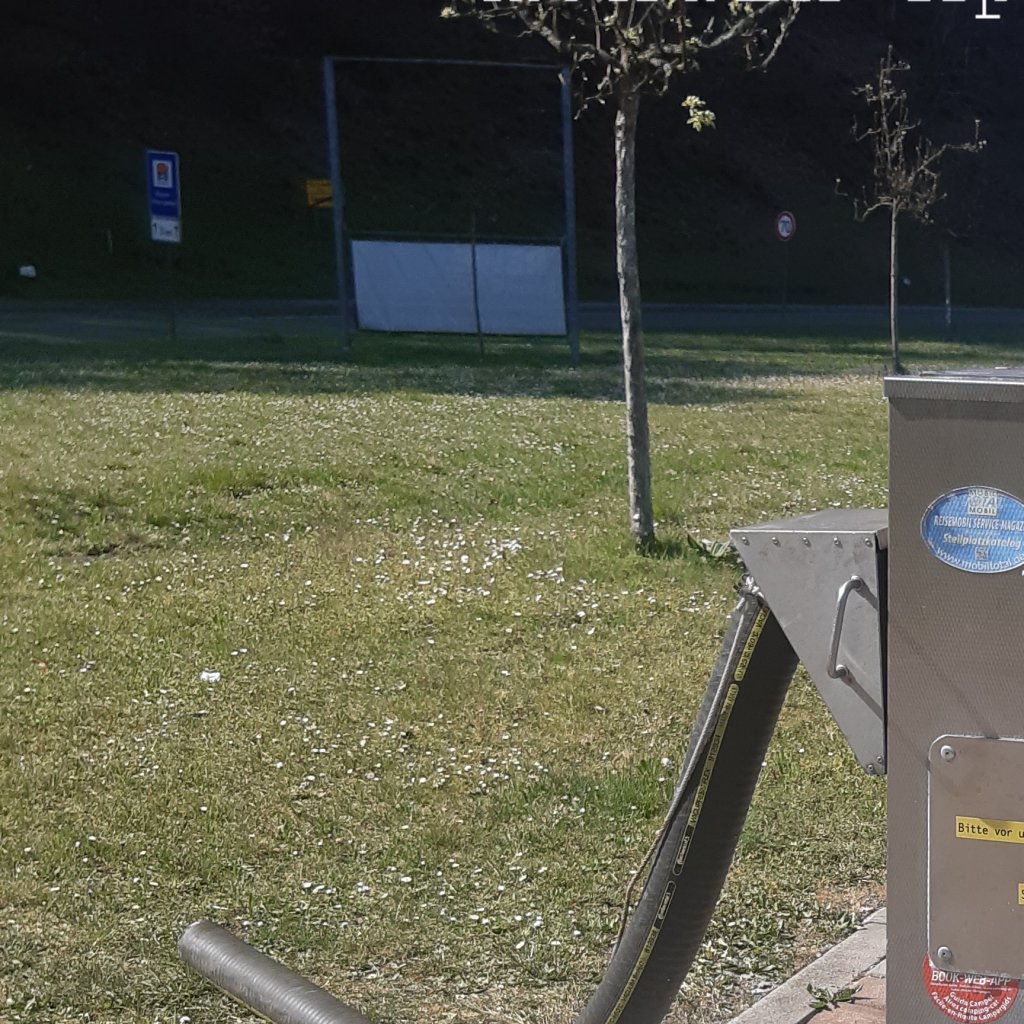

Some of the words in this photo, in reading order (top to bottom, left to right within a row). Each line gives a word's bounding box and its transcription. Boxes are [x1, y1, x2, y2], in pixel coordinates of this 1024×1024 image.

[969, 507, 996, 515] MOBIL
[934, 515, 974, 529] REISEMOBIL
[943, 533, 1021, 550] Stellplatzkatalog
[958, 822, 989, 836] Bitte
[994, 827, 1013, 837] vor
[950, 991, 968, 1006] Guida
